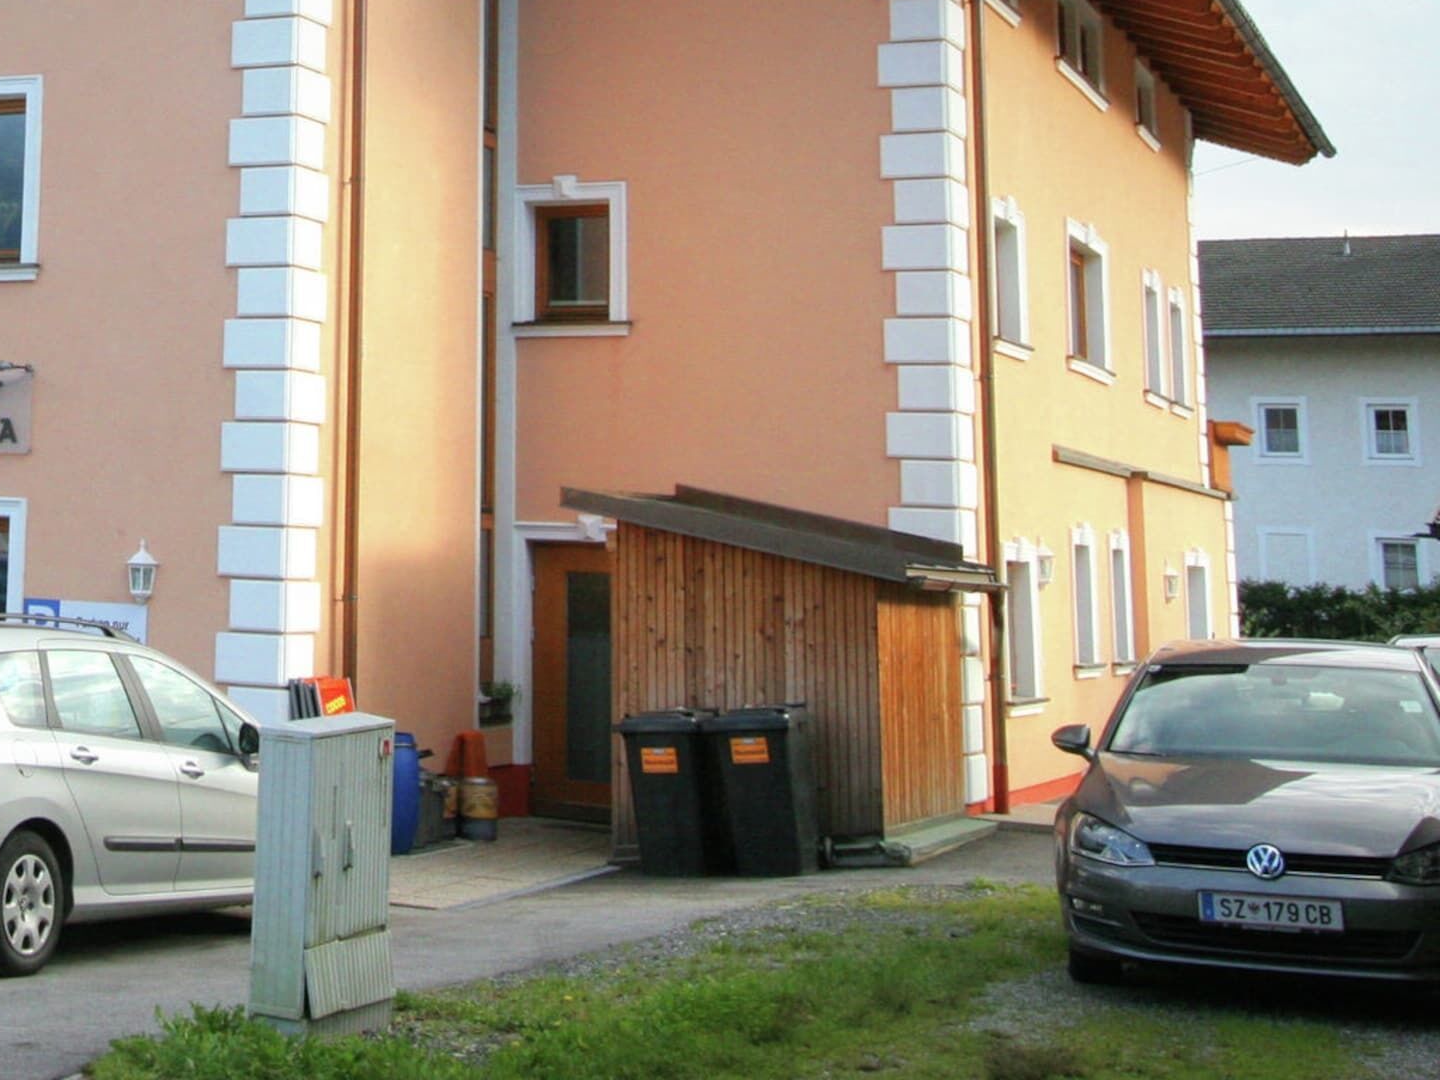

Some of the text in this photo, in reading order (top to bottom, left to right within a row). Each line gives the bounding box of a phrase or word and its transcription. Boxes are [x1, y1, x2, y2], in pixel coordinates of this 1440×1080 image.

[1220, 898, 1332, 925] SZ 179 CB
